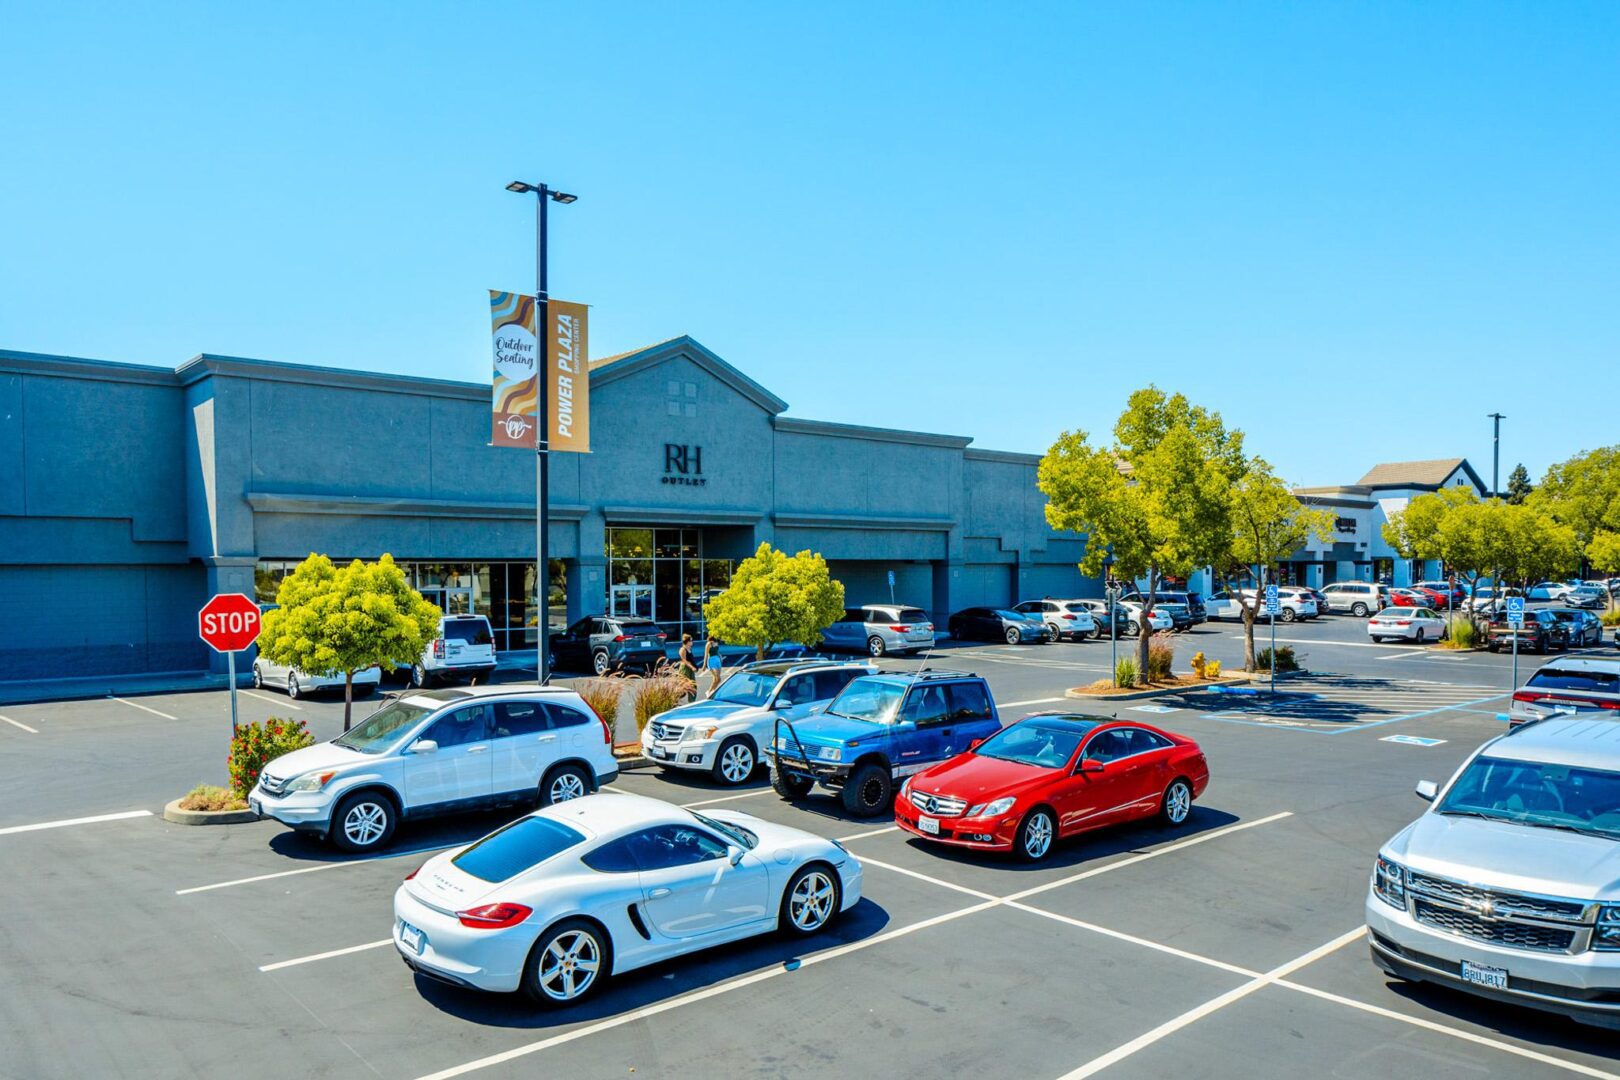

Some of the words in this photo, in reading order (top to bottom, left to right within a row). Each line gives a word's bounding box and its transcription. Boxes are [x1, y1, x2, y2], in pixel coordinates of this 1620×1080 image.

[496, 336, 534, 352] Outdoor
[558, 314, 573, 372] PLAZA
[496, 350, 534, 370] Seating
[558, 378, 573, 437] POWER
[664, 443, 703, 475] RH
[661, 477, 707, 486] OUTLET
[203, 611, 257, 635] STOP
